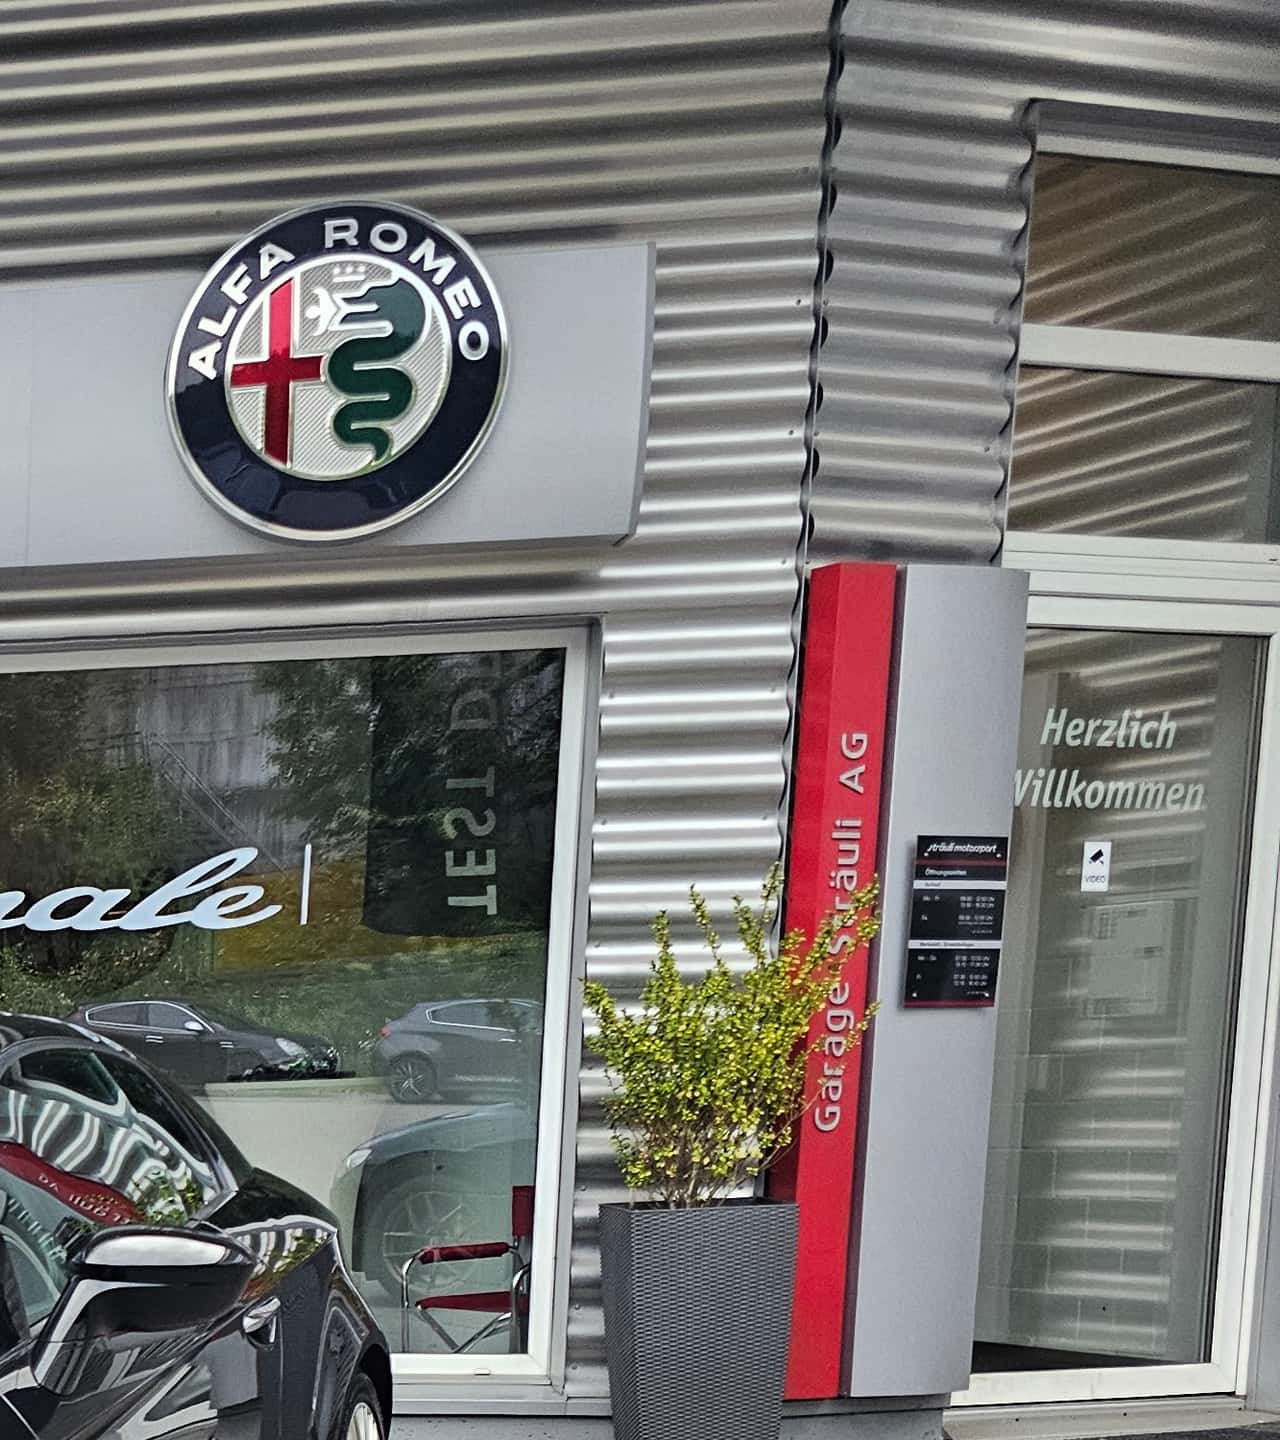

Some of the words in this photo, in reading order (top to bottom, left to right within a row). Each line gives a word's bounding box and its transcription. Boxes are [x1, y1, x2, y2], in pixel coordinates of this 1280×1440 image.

[187, 240, 296, 380] ALFA
[323, 217, 491, 361] ROMEO
[1039, 707, 1178, 749] Herzlich
[1084, 874, 1107, 884] VIDEO
[814, 980, 855, 1133] Garage
[839, 732, 868, 795] AG
